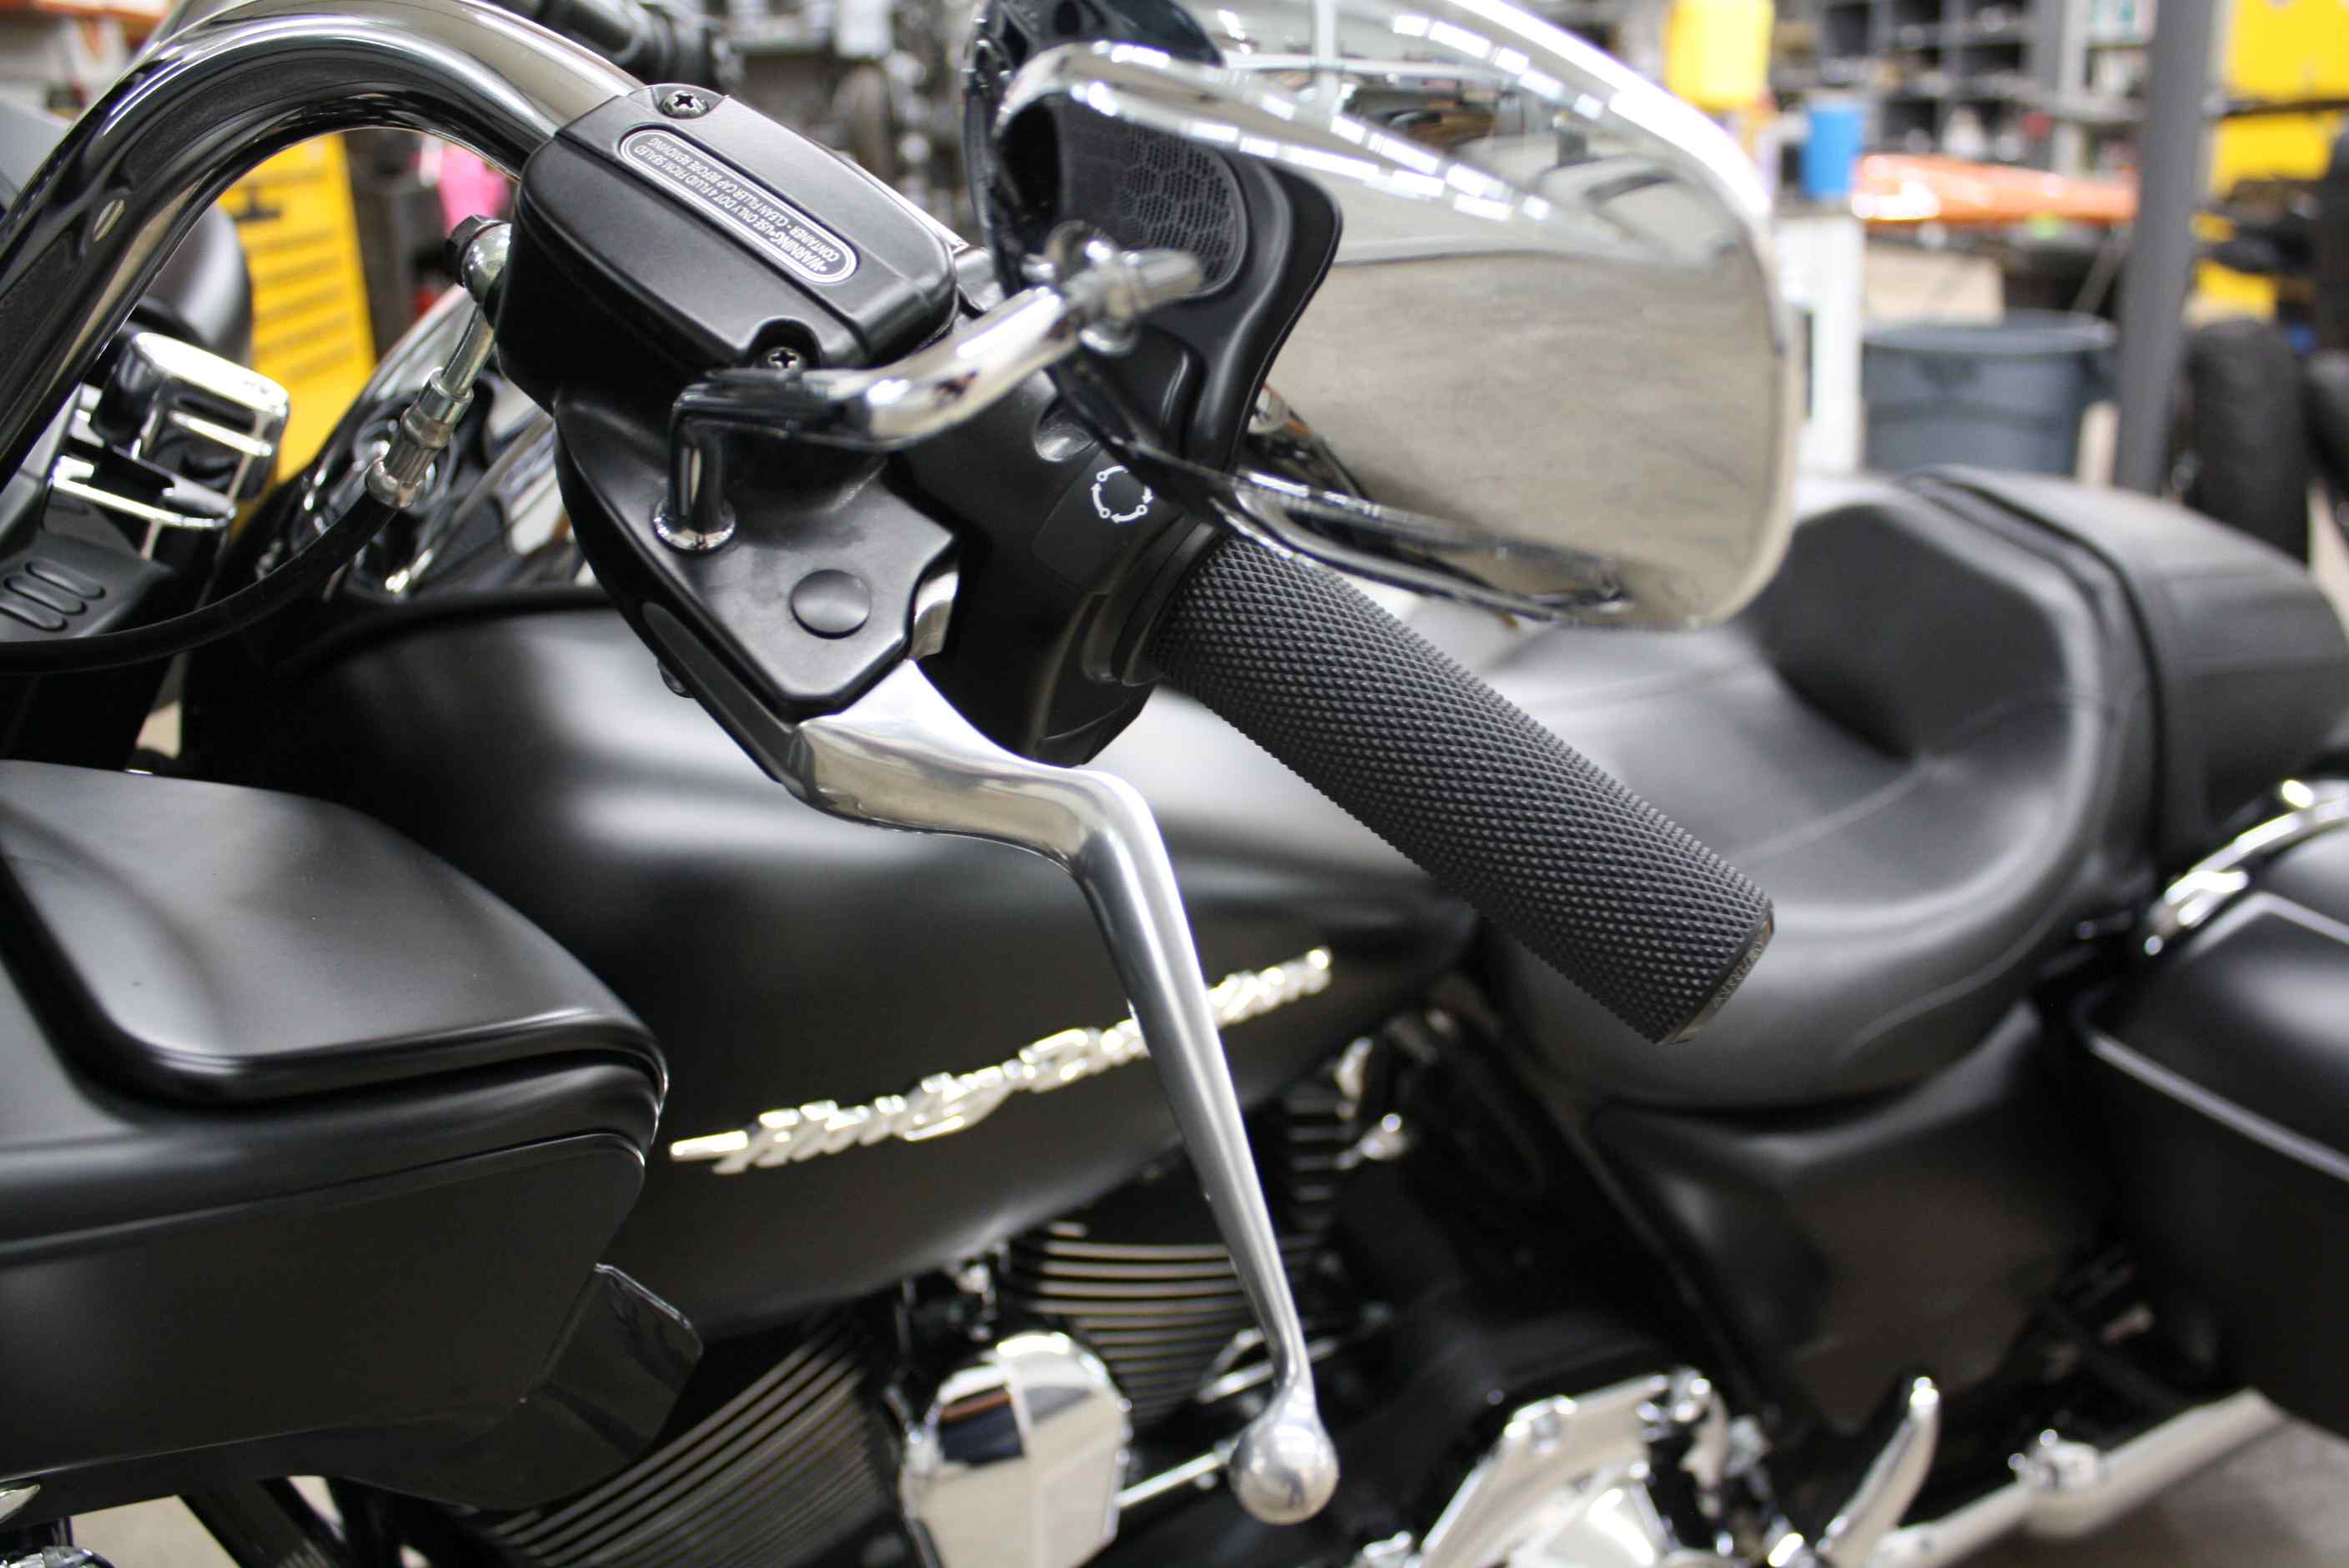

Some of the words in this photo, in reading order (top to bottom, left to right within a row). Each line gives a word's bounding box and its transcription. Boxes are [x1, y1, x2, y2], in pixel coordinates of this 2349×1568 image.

[634, 145, 666, 165] SEALED
[647, 138, 693, 165] REMOVING
[661, 162, 689, 179] FROM
[687, 160, 722, 183] BEFORE
[685, 174, 712, 193] FLUID
[716, 179, 738, 193] CAP
[712, 193, 736, 209] DOT
[732, 188, 763, 209] FILLER
[731, 205, 758, 223] ONLY
[757, 205, 788, 227] CLEAN
[789, 226, 839, 262] CONTAINER
